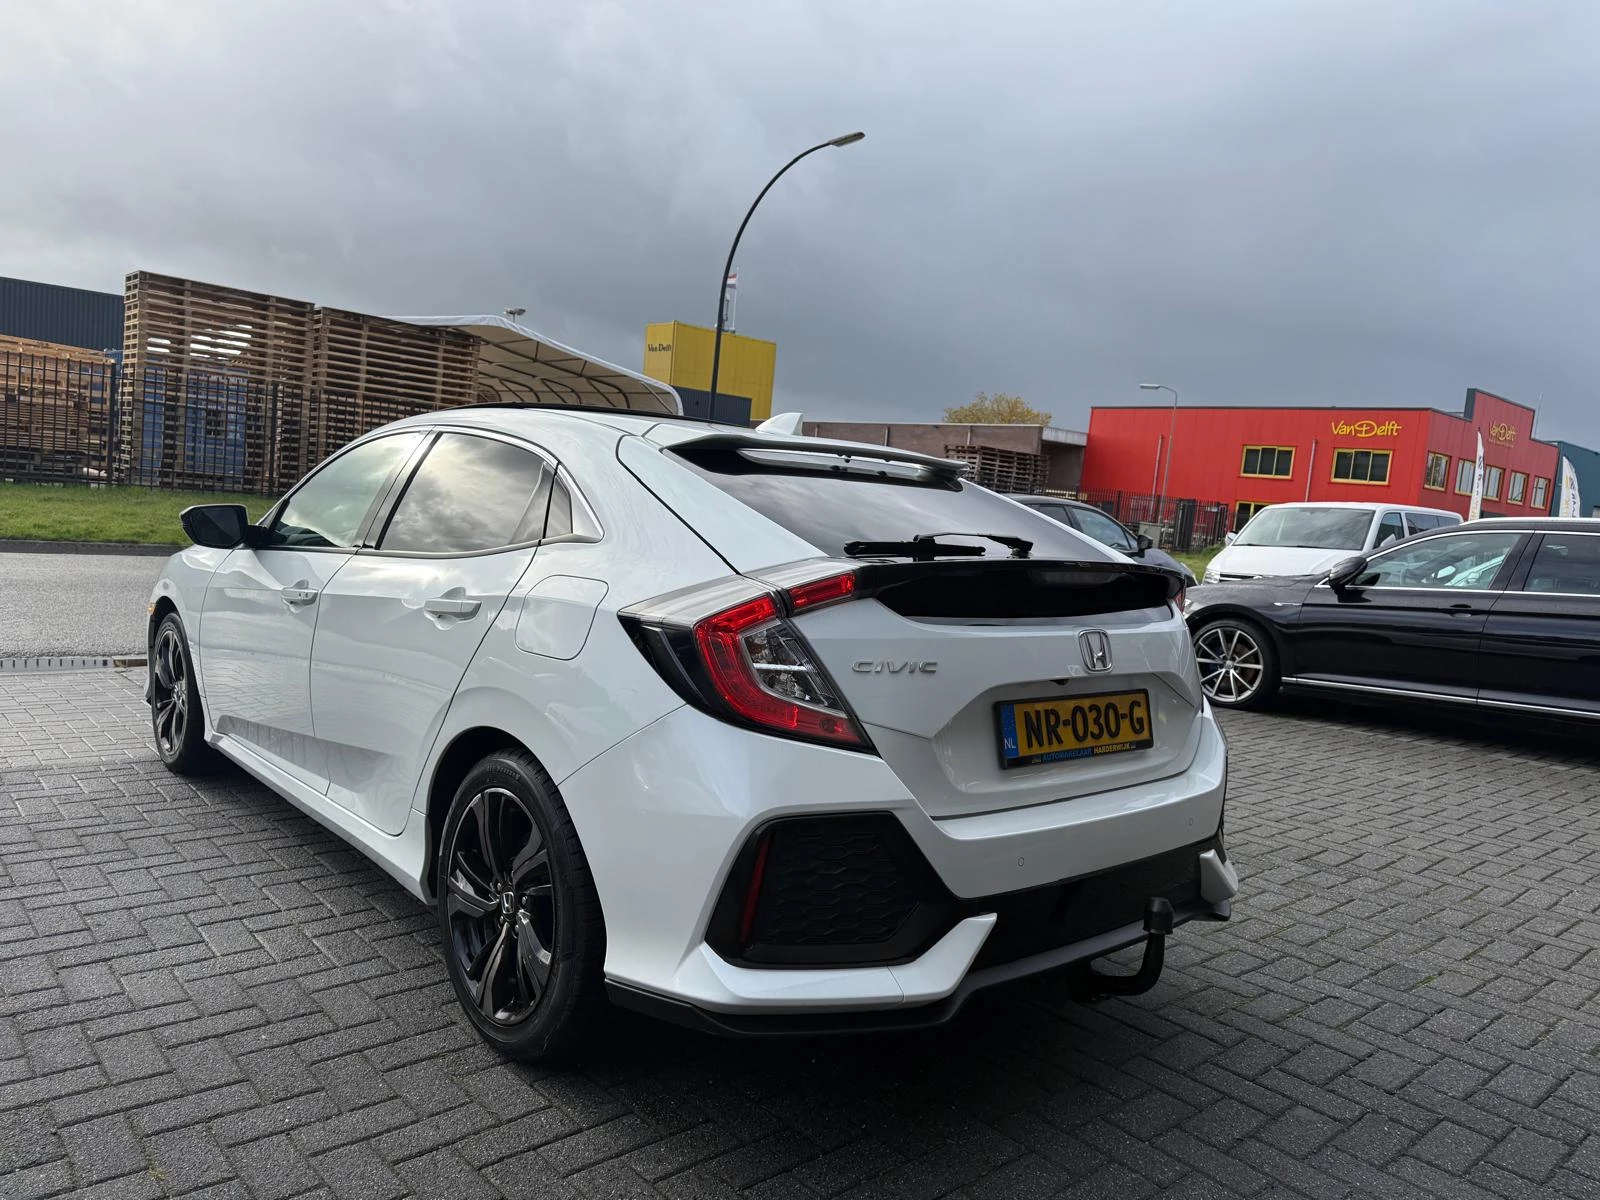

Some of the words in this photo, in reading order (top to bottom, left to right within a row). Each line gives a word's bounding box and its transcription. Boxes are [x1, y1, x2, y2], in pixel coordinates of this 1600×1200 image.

[851, 661, 938, 673] CIVIC
[1024, 700, 1145, 749] NR-030-G
[1004, 737, 1017, 749] NL
[1093, 742, 1131, 754] HARDERWIJK
